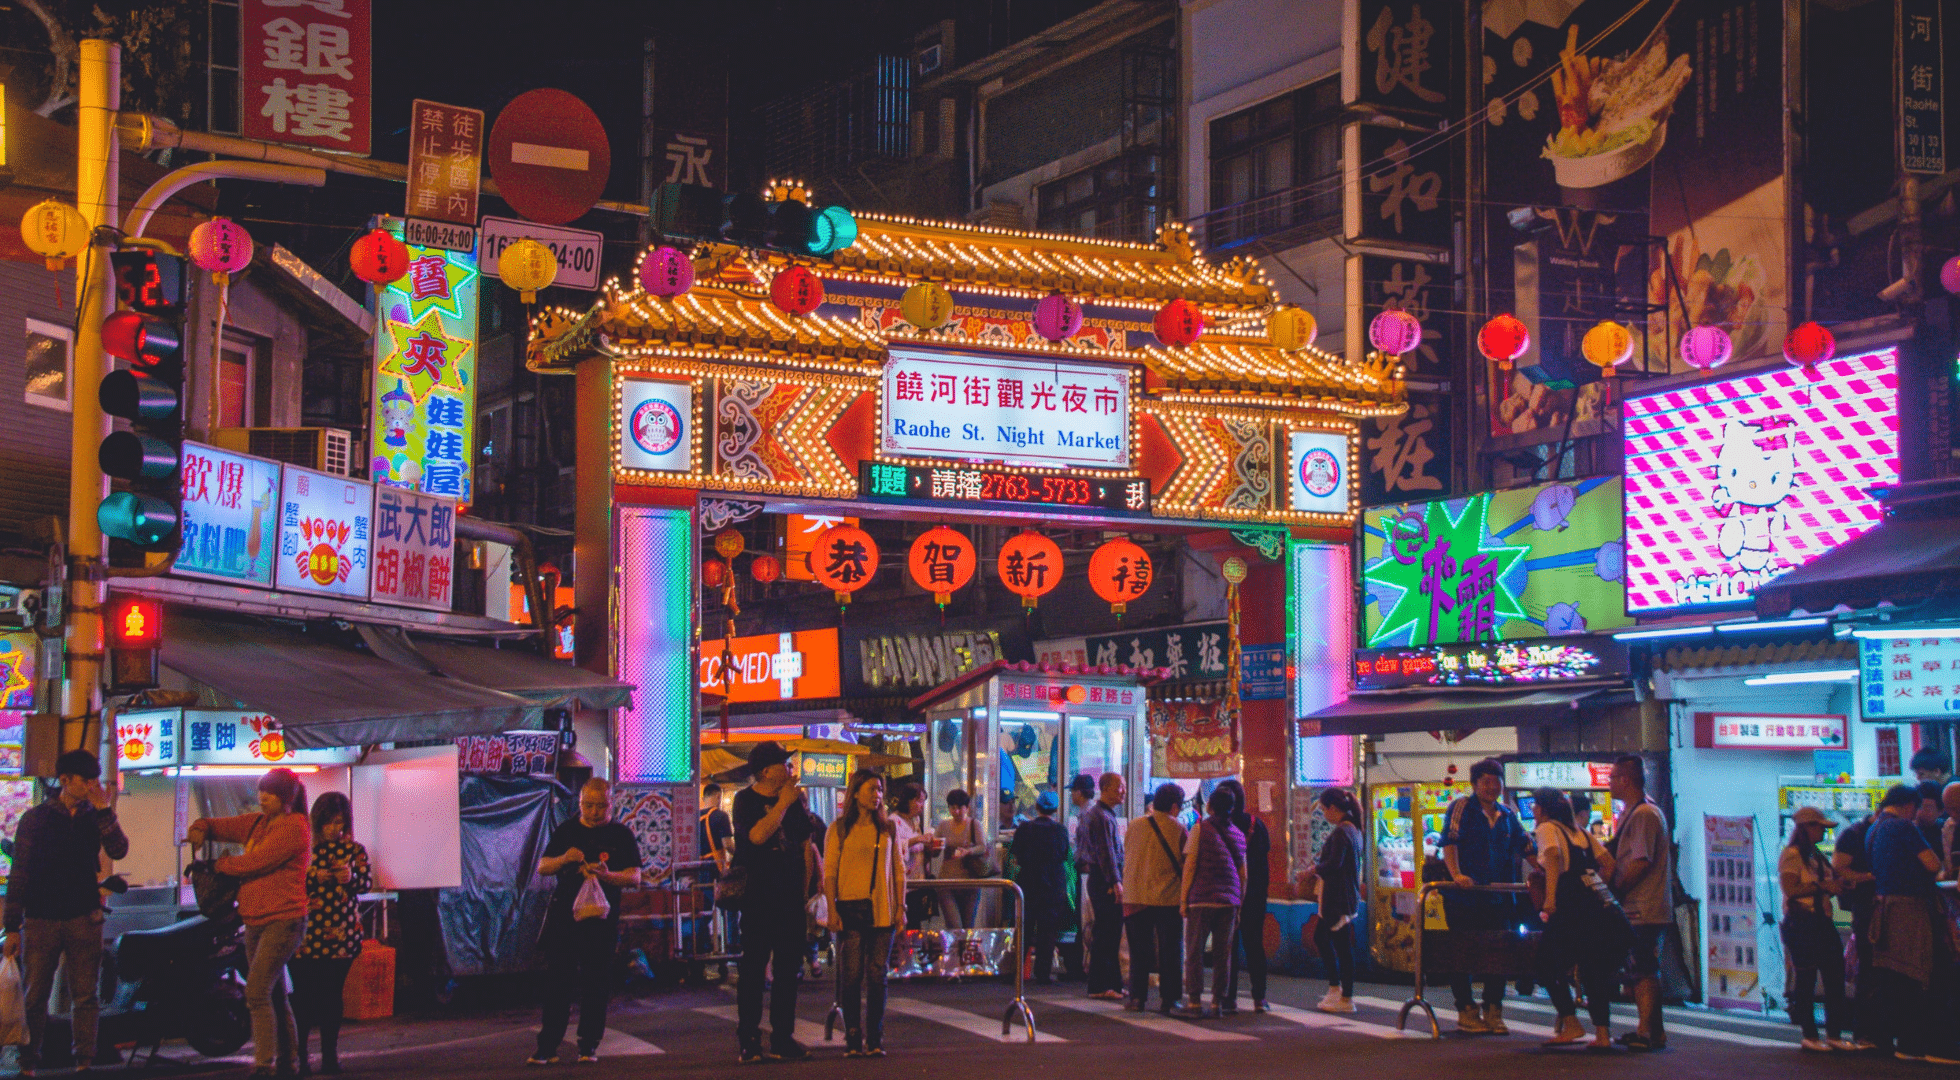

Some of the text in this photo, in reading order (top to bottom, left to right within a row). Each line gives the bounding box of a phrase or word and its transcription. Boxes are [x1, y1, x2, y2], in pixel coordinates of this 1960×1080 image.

[259, 0, 354, 141] 銀樓
[414, 107, 446, 212] 禁止停車
[450, 111, 476, 218] 徒步區內
[408, 222, 471, 249] 16:00-24:00
[894, 369, 1119, 416] 饒河街觀光夜市
[425, 394, 465, 497] 娃娃屋
[893, 418, 1121, 451] Raohe St. Night Market
[379, 494, 452, 549] 武大郎
[376, 546, 451, 602] 胡椒餅
[922, 539, 962, 586] 賀
[1006, 550, 1050, 590] 新
[700, 652, 771, 688] COMED
[1374, 655, 1398, 673] claw
[1402, 656, 1434, 676] games
